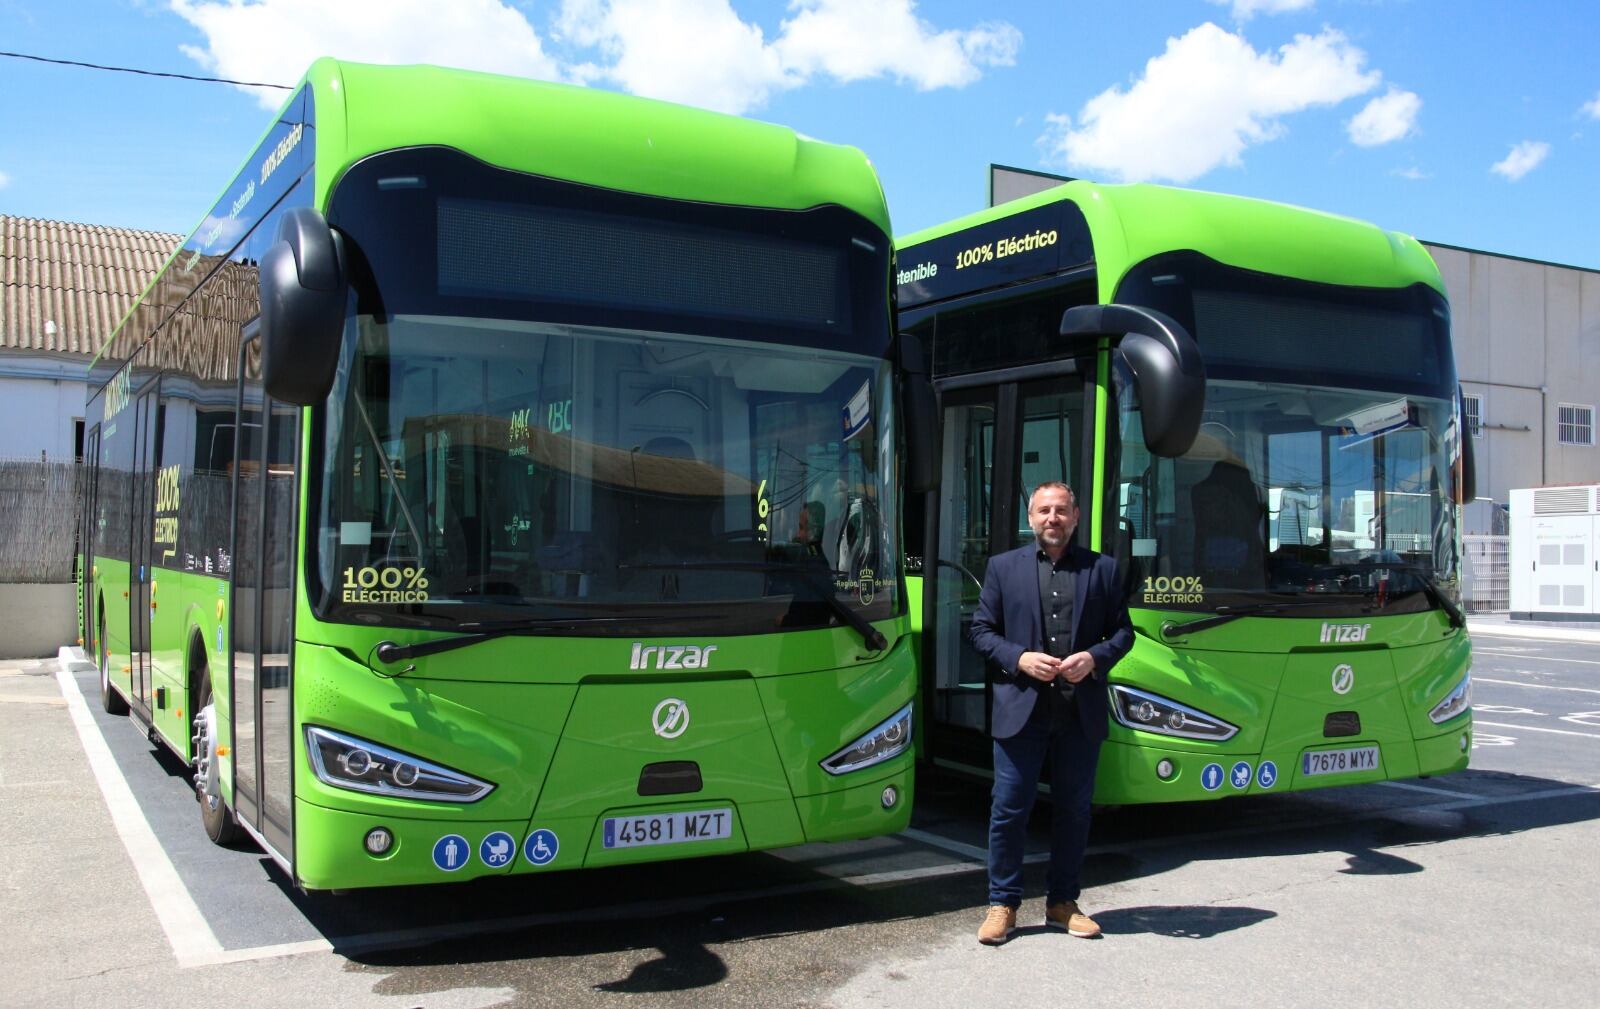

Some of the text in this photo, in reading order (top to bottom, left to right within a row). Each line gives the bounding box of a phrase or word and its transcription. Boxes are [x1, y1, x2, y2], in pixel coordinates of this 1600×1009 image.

[955, 242, 994, 270] 100%
[996, 229, 1058, 259] Eléctrico
[156, 464, 180, 513] 100%
[343, 566, 429, 589] 100%
[1143, 576, 1204, 593] 100%
[343, 588, 429, 603] ELÉCTRICO
[1319, 621, 1372, 643] Irizar
[629, 642, 718, 670] Irizar
[1312, 749, 1375, 772] 7678 MYX
[619, 812, 726, 843] 4581 MZT
